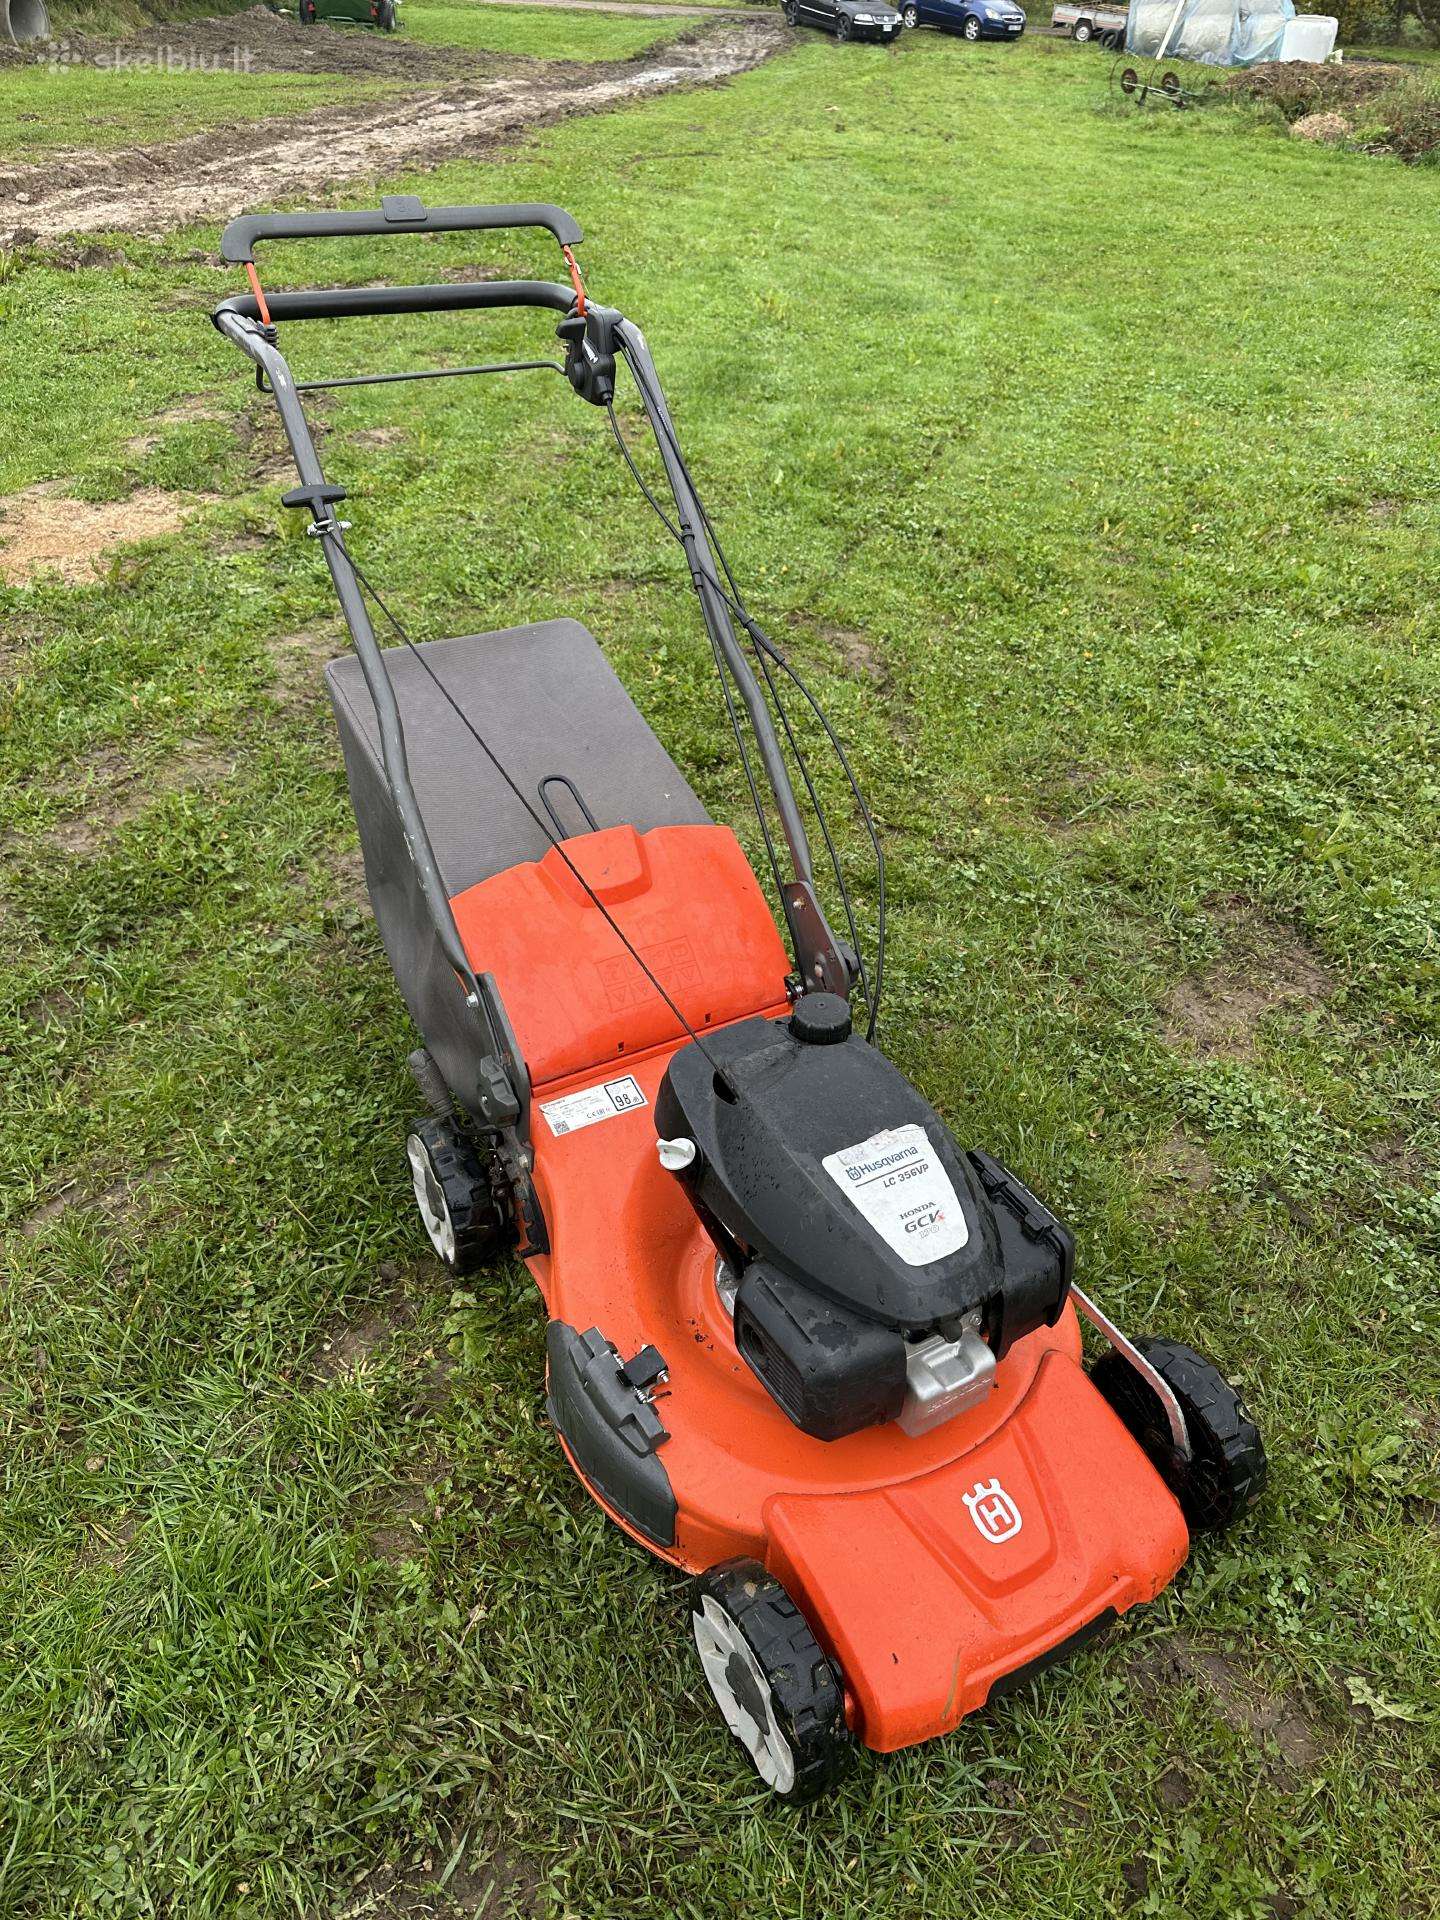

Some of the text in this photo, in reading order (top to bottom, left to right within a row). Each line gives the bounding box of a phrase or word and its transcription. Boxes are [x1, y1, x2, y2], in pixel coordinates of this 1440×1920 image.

[615, 1094, 631, 1106] 98
[859, 1146, 918, 1175] Husqvarna
[883, 1164, 929, 1188] LC 356VP
[899, 1201, 936, 1220] HONDA
